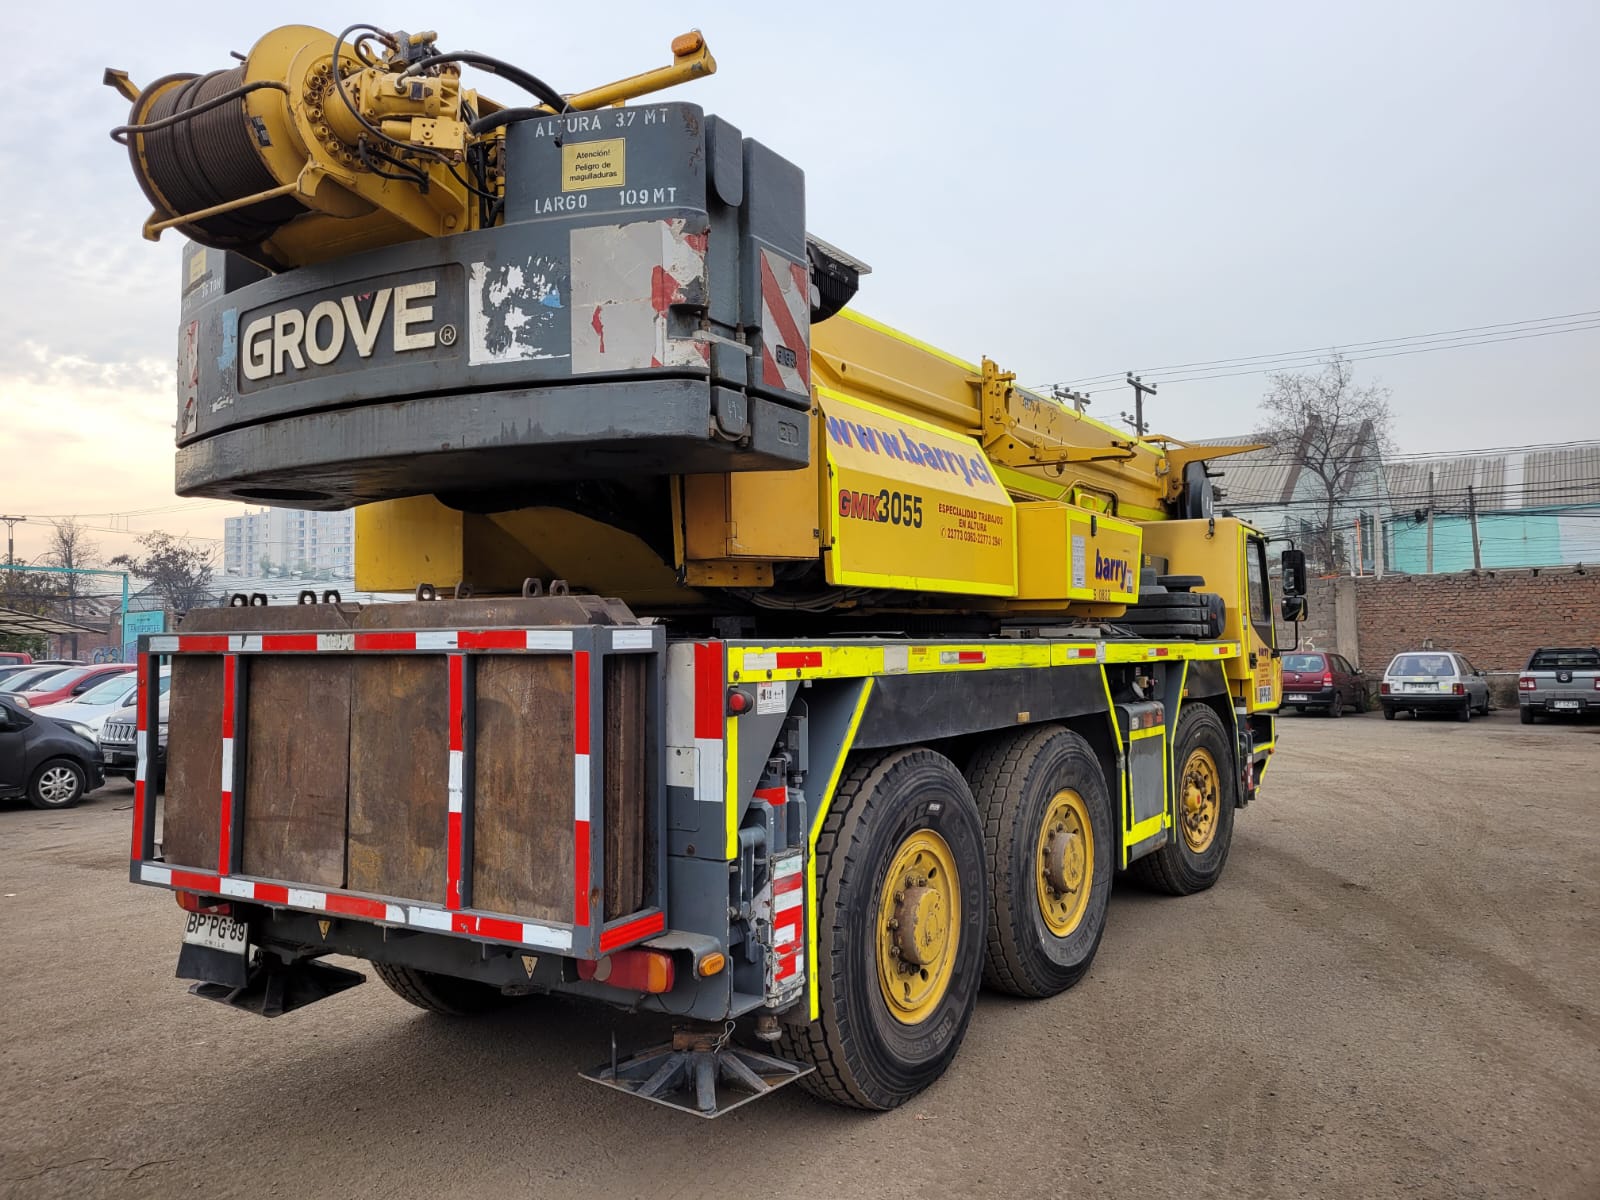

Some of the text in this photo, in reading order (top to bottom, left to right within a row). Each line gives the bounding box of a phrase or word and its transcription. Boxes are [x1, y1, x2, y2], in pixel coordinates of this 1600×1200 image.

[644, 107, 669, 125] MT
[576, 149, 611, 160] Atención!
[569, 171, 618, 182] magulladuras
[575, 161, 611, 172] Peligro de
[534, 194, 588, 214] LARGO
[652, 187, 677, 204] MT
[242, 280, 437, 381] GROVE
[826, 416, 995, 486] www.barry.cl
[839, 489, 923, 529] GMK3055
[938, 503, 1003, 525] ESPECIALIDAD TRABAJOS
[959, 519, 987, 532] EN ALTURA
[1096, 548, 1127, 590] barry
